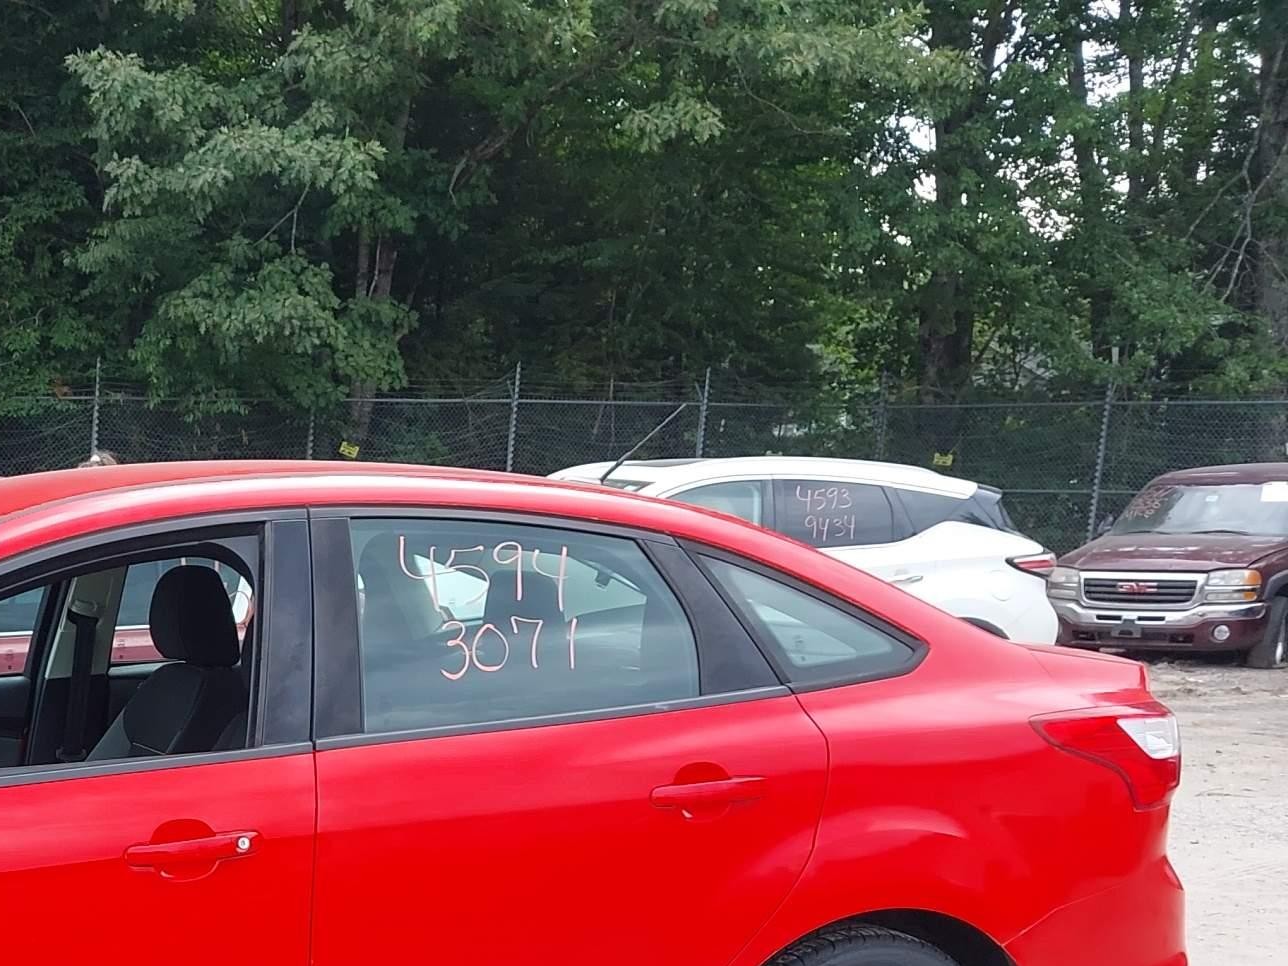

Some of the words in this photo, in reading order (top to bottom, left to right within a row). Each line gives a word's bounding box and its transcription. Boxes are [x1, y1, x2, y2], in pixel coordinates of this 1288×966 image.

[795, 484, 853, 513] 4593
[804, 514, 856, 541] 9434
[398, 535, 568, 613] 4594
[439, 615, 579, 681] 3071
